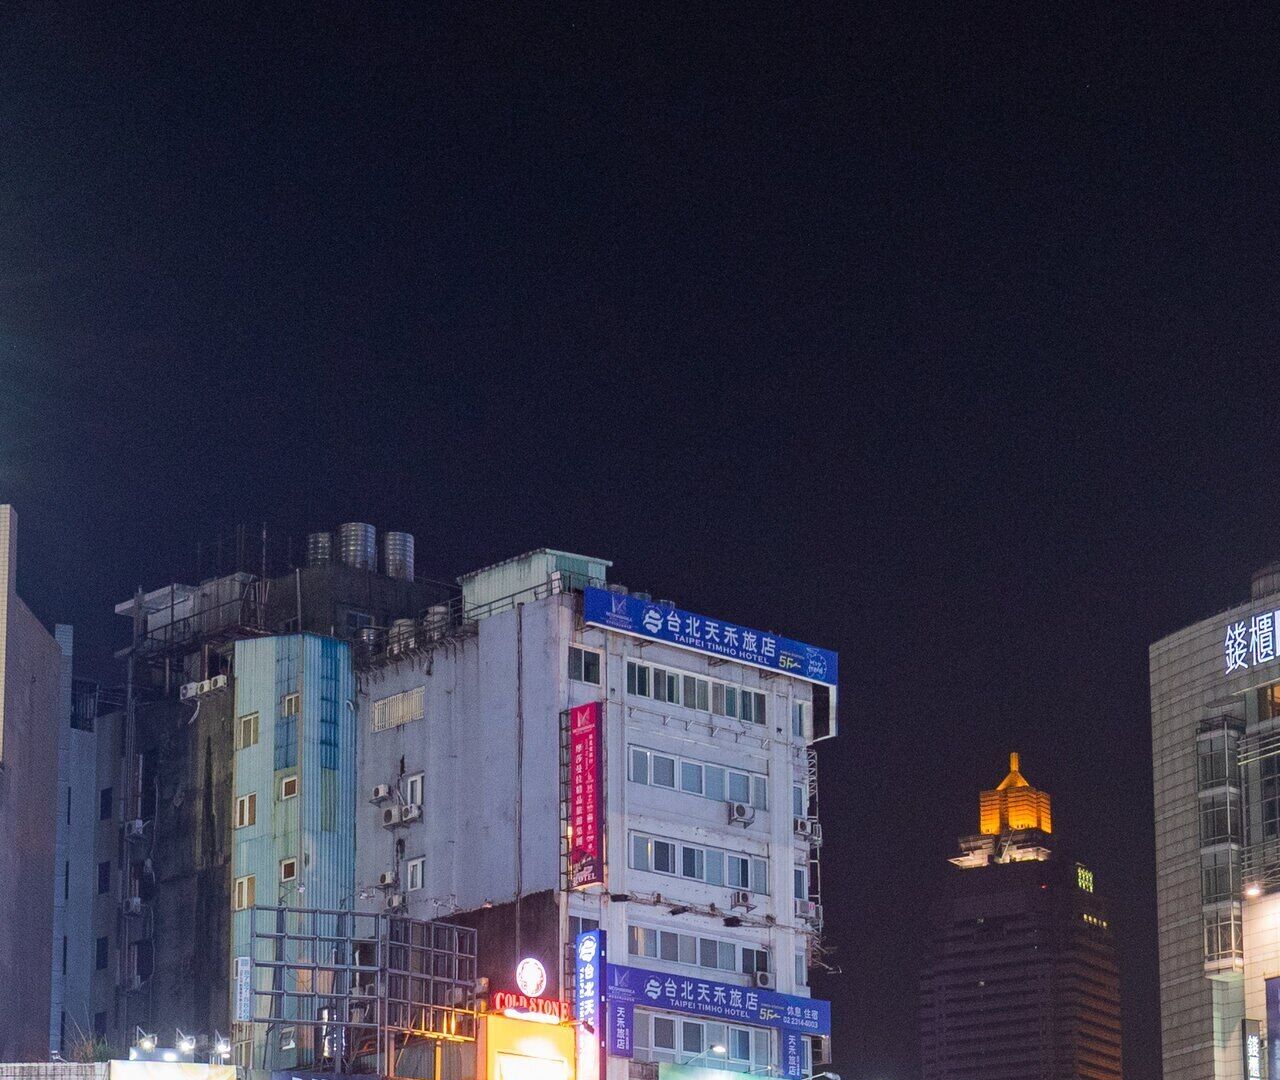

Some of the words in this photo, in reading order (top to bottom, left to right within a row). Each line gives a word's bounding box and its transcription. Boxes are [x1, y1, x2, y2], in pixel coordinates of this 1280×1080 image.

[666, 611, 777, 657] 台北天禾旅店
[674, 633, 704, 648] TAIPEI
[706, 641, 737, 656] TIMHO
[739, 650, 770, 665] HOTEL
[494, 991, 527, 1011] COLD
[528, 997, 571, 1022] STONE
[664, 977, 759, 1011] 台北天禾旅店
[670, 999, 696, 1009] TAIPEI
[698, 1003, 723, 1014] TIMHO
[724, 1007, 751, 1018] HOTEL
